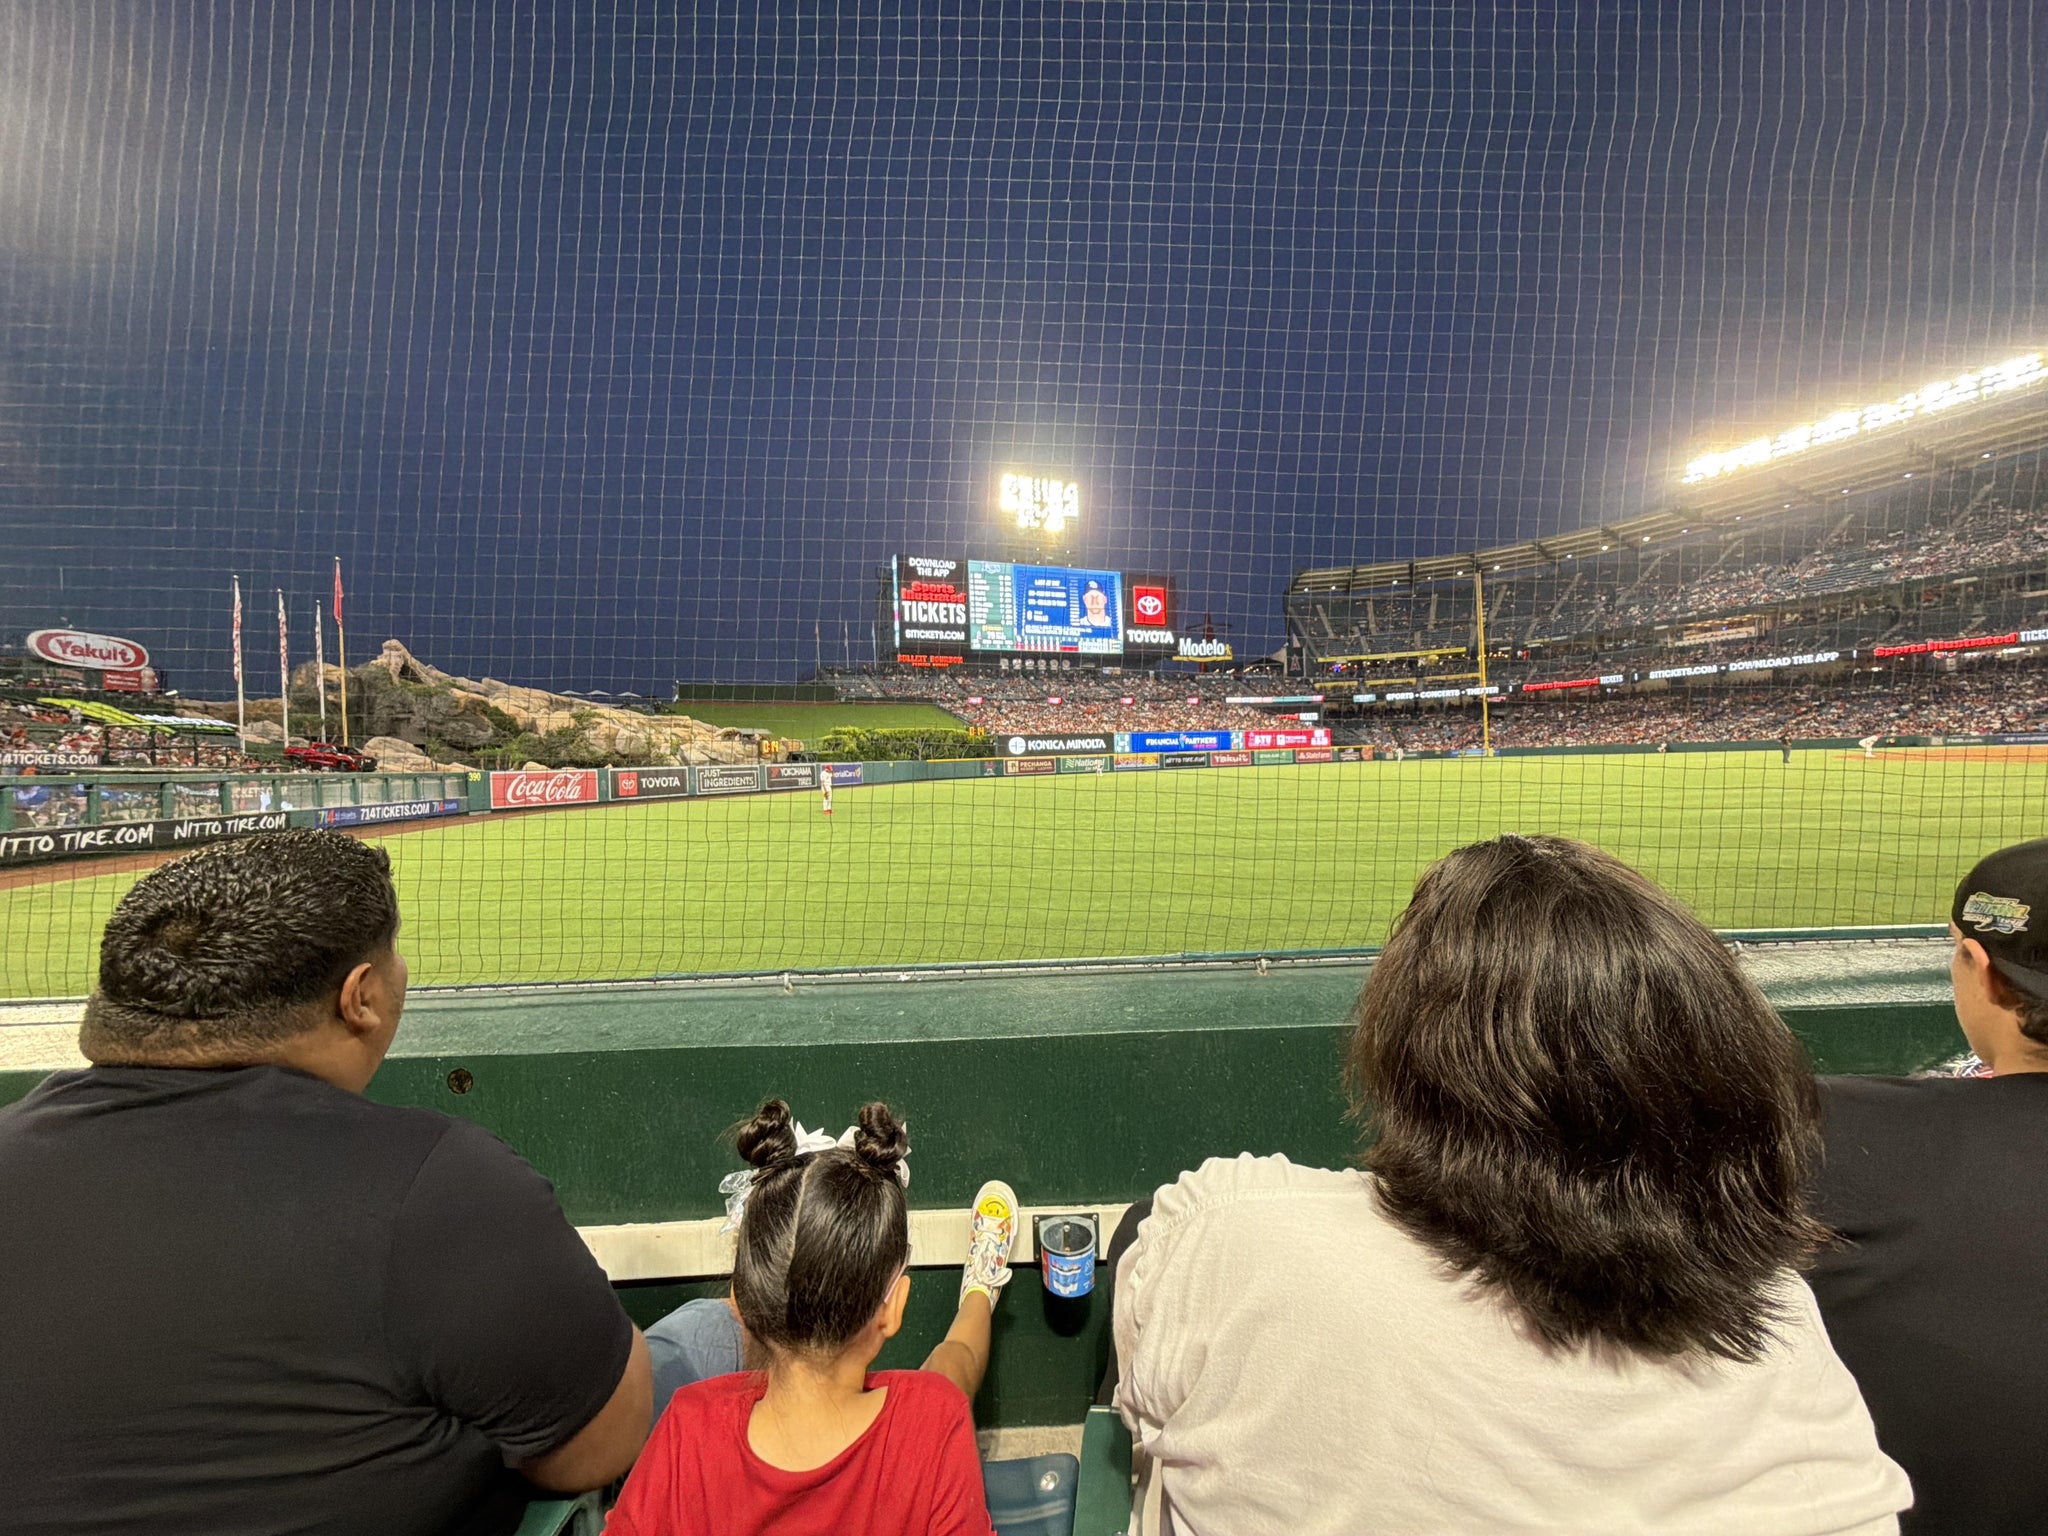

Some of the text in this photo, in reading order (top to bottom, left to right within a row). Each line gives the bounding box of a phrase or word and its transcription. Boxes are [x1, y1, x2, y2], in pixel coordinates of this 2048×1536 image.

[909, 557, 956, 570] DOWNLOAD
[917, 567, 949, 578] THE APP
[911, 581, 956, 594] Sports
[901, 601, 966, 624] TICKETS
[1126, 629, 1175, 644] TOYOTA
[1873, 629, 2048, 657] Sports Illustrated TICK
[55, 638, 132, 663] Yakult
[1179, 637, 1225, 656] Modelo
[1728, 657, 1791, 672] DOWNLOAD
[1792, 654, 1814, 666] THE
[1815, 651, 1840, 663] APP
[1420, 689, 1460, 699] CONCERTS
[1028, 739, 1065, 751] KONICA
[1066, 738, 1106, 750] MINOLTA
[1214, 754, 1248, 763] Yakult
[468, 772, 481, 781] 390
[703, 769, 721, 778] JUST
[780, 767, 812, 777] YOKOHAMA
[641, 776, 681, 789] TOYOTA
[704, 776, 754, 788] INGREDIENTS
[360, 802, 430, 820] 714TICKETS.COM
[60, 823, 154, 852] TIRE.COM
[173, 819, 222, 840] NITTO
[226, 813, 286, 834] TIRE.COM
